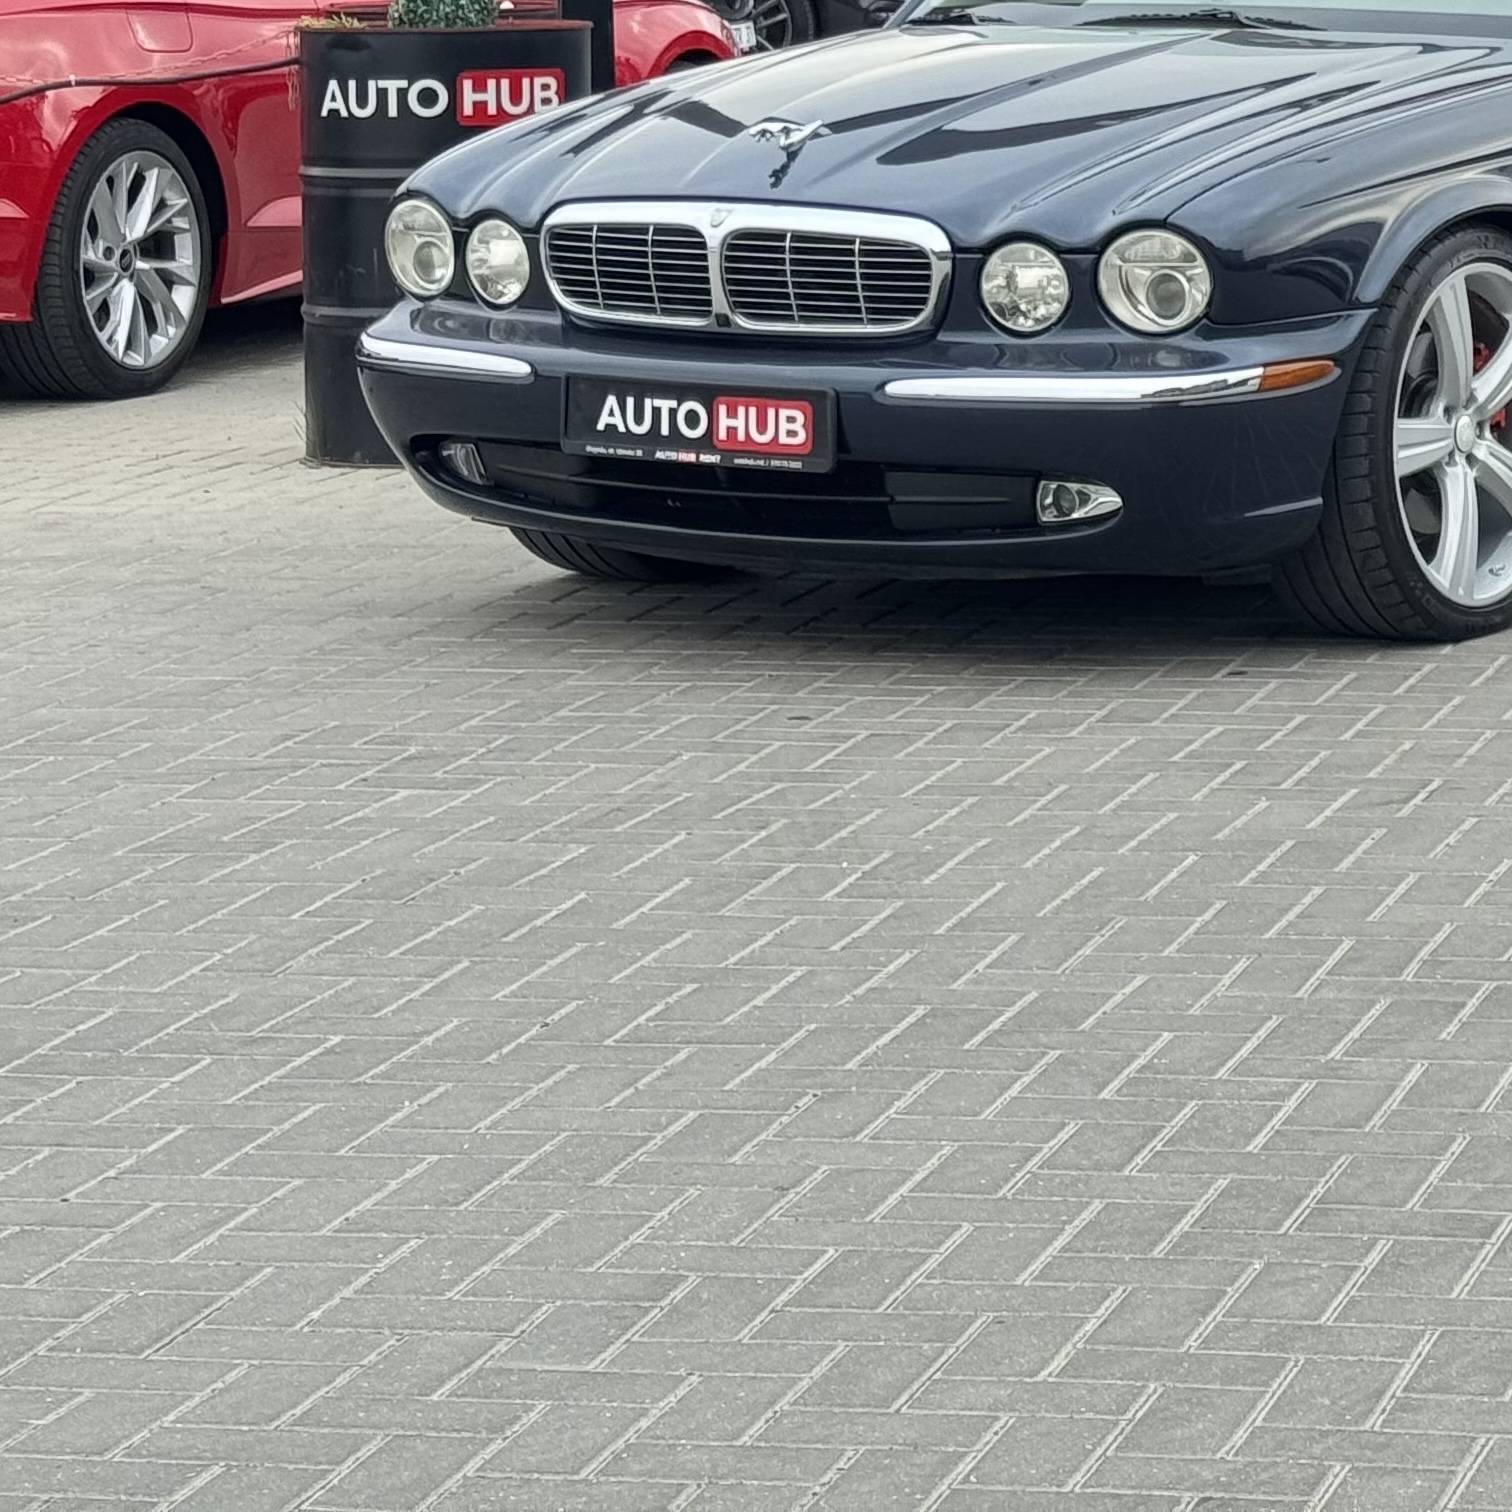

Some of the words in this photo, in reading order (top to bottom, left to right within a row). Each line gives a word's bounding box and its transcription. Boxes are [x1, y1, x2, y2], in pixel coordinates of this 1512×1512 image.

[320, 79, 449, 118] AUTO
[462, 76, 560, 116] HUB
[596, 394, 709, 439] AUTO
[718, 404, 807, 445] HUB
